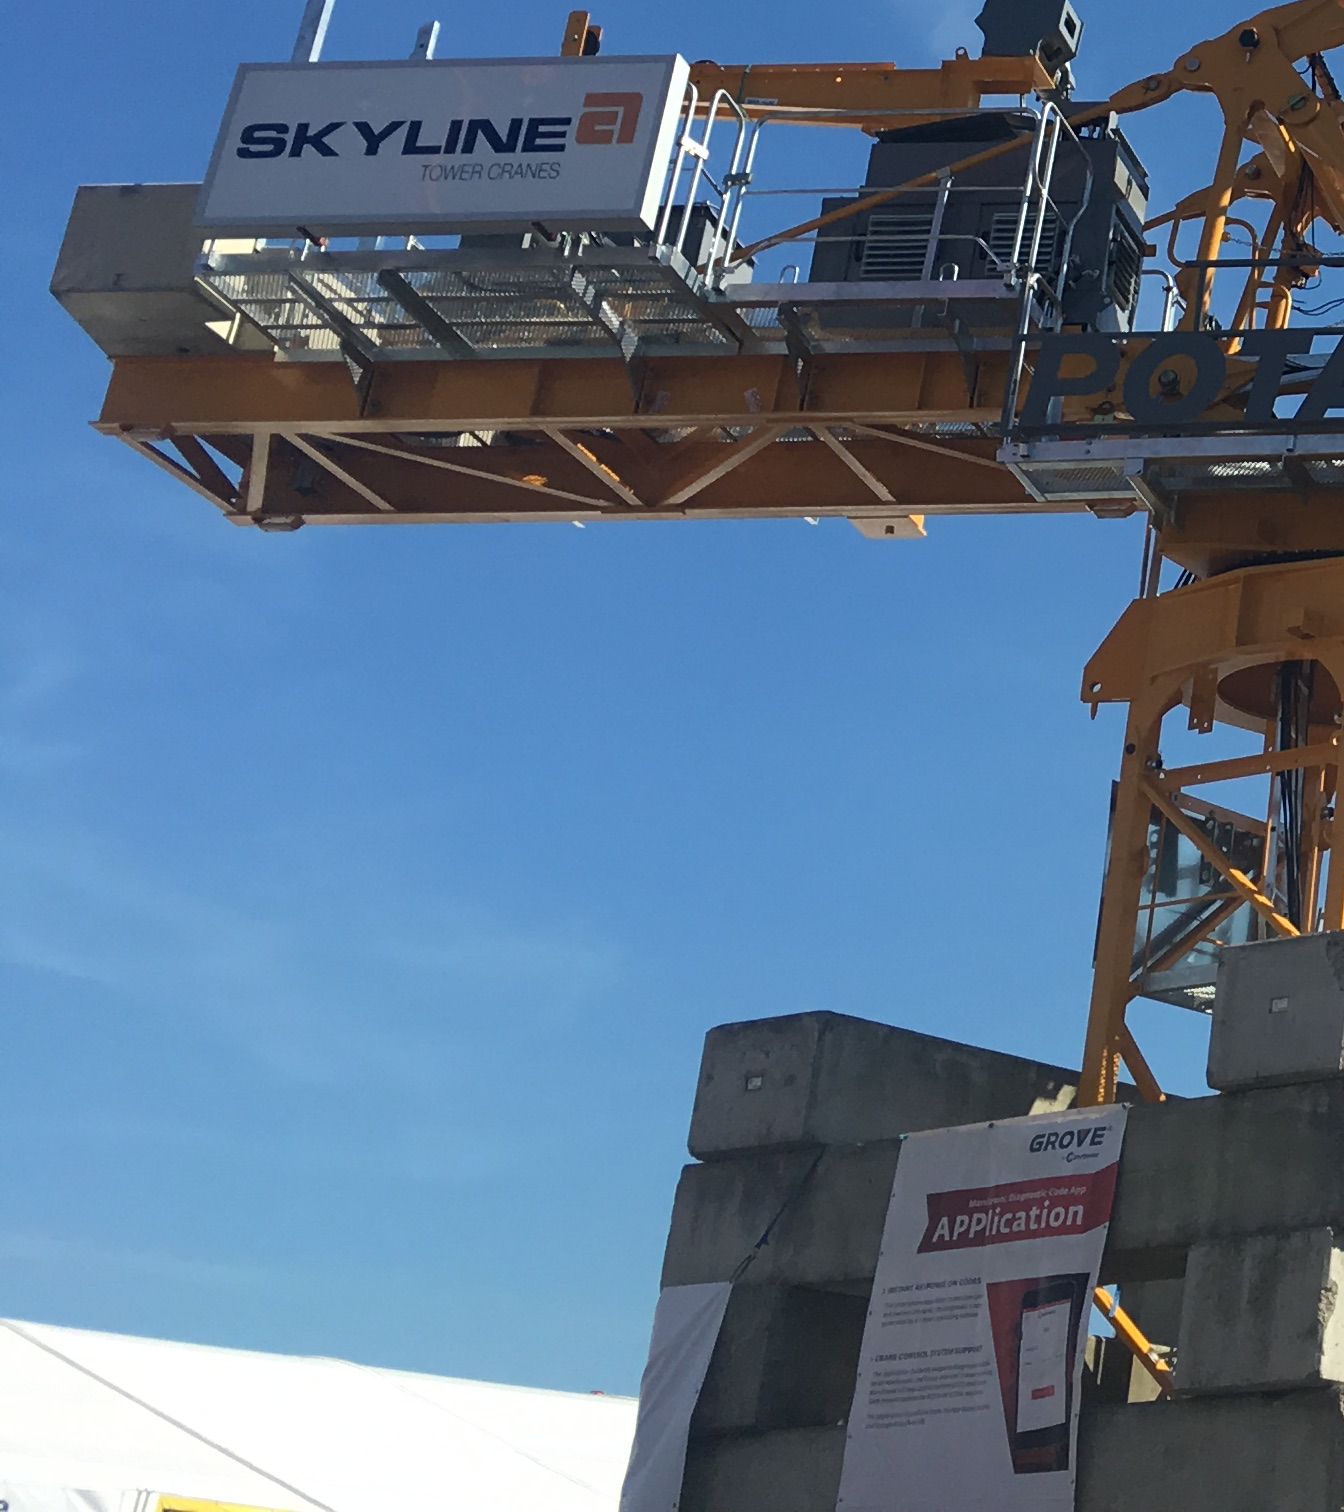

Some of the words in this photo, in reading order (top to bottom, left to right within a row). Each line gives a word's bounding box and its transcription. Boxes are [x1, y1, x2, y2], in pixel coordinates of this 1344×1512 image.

[236, 116, 573, 159] SKYLINE
[421, 164, 484, 182] TOWER
[487, 162, 561, 180] CRANES
[1029, 1126, 1107, 1153] GROVE
